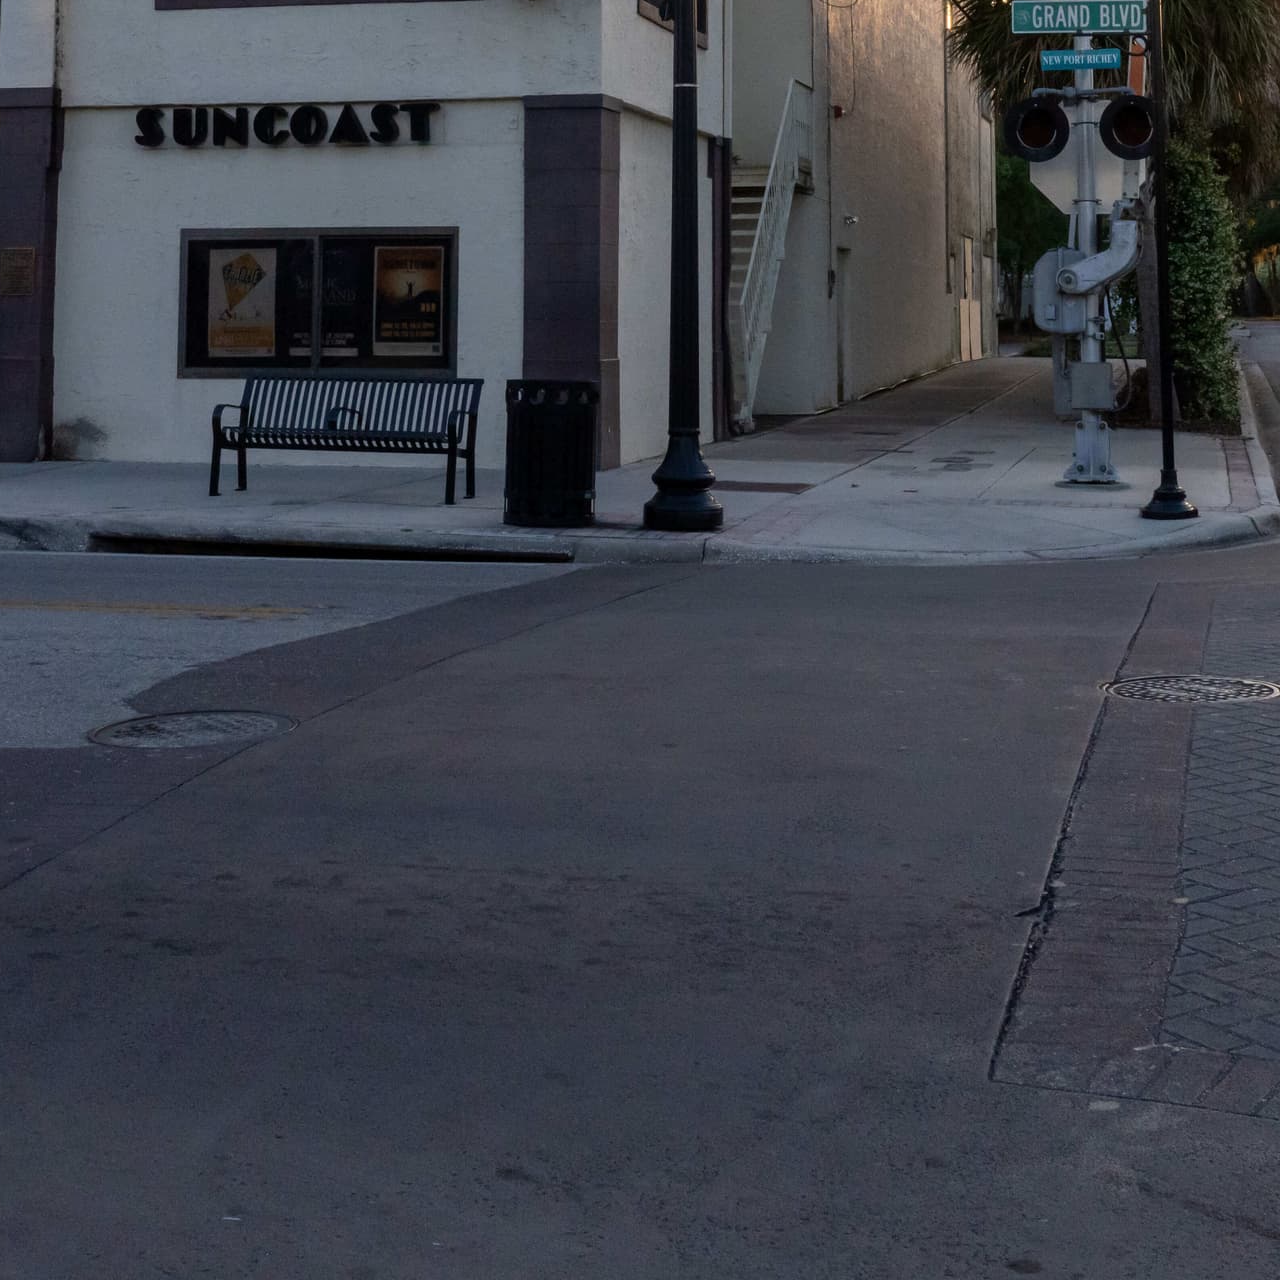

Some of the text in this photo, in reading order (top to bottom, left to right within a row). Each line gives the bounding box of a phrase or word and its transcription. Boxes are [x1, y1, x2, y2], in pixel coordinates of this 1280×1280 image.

[1032, 4, 1141, 29] GRAND BLVD
[1042, 53, 1118, 65] NEW PORT RICHEY
[134, 103, 441, 146] SUNCOAST
